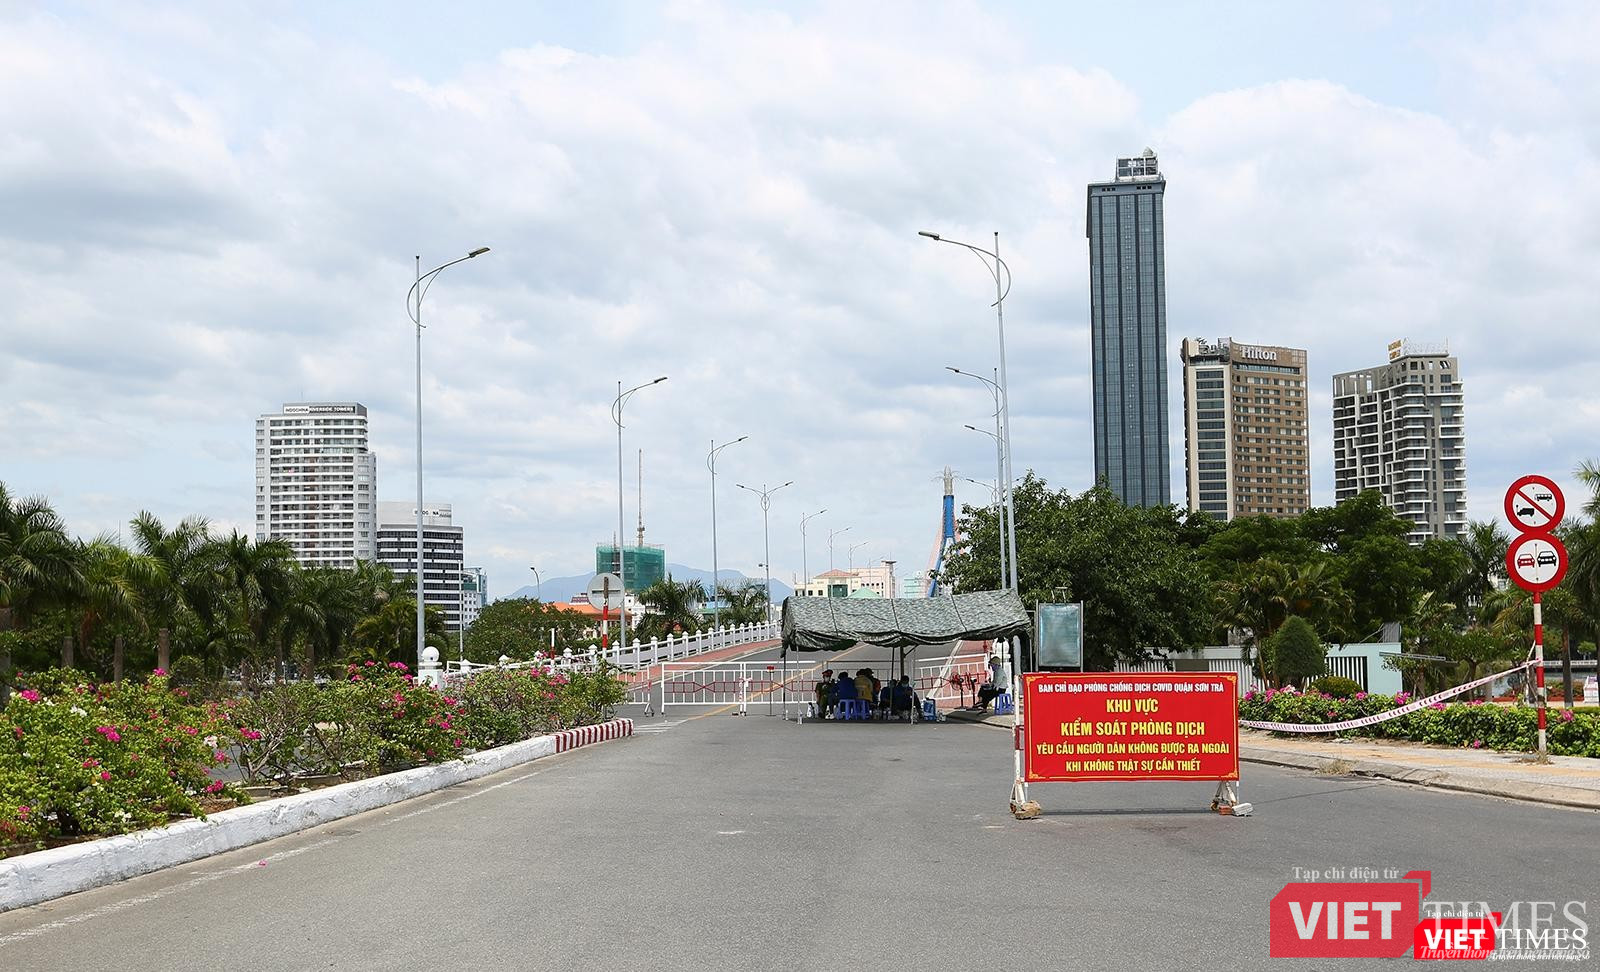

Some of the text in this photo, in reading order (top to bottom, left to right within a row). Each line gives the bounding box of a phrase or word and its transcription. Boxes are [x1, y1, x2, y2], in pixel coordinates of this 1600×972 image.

[1241, 346, 1277, 361] Hilton
[1038, 684, 1053, 693] BAN
[1068, 684, 1082, 694] ĐẠO
[1083, 682, 1108, 692] PHÒNG
[1109, 680, 1133, 692] CHỐNG
[1134, 683, 1151, 693] DỊCH
[1152, 683, 1173, 692] COVID
[1174, 682, 1193, 693] QUẬN
[1194, 683, 1209, 692] SƠN
[1210, 682, 1224, 692] TRÀ
[1106, 698, 1159, 715] KHU VỰC
[1061, 717, 1205, 738] KIỂM SOÁT PHÒNG DỊCH
[1036, 742, 1054, 754] YÊU
[1077, 740, 1104, 753] NGƯỜI
[1107, 741, 1125, 753] DÂN
[1128, 741, 1158, 753] KHÔNG
[1161, 742, 1185, 755] ĐƯỢC
[1187, 743, 1200, 753] RA
[1201, 741, 1229, 753] NGOÀI
[1066, 761, 1081, 772] KHI
[1083, 759, 1115, 772] KHÔNG
[1117, 759, 1139, 773] THẬT
[1141, 760, 1154, 773] SỰ
[1176, 757, 1201, 770] THIẾT
